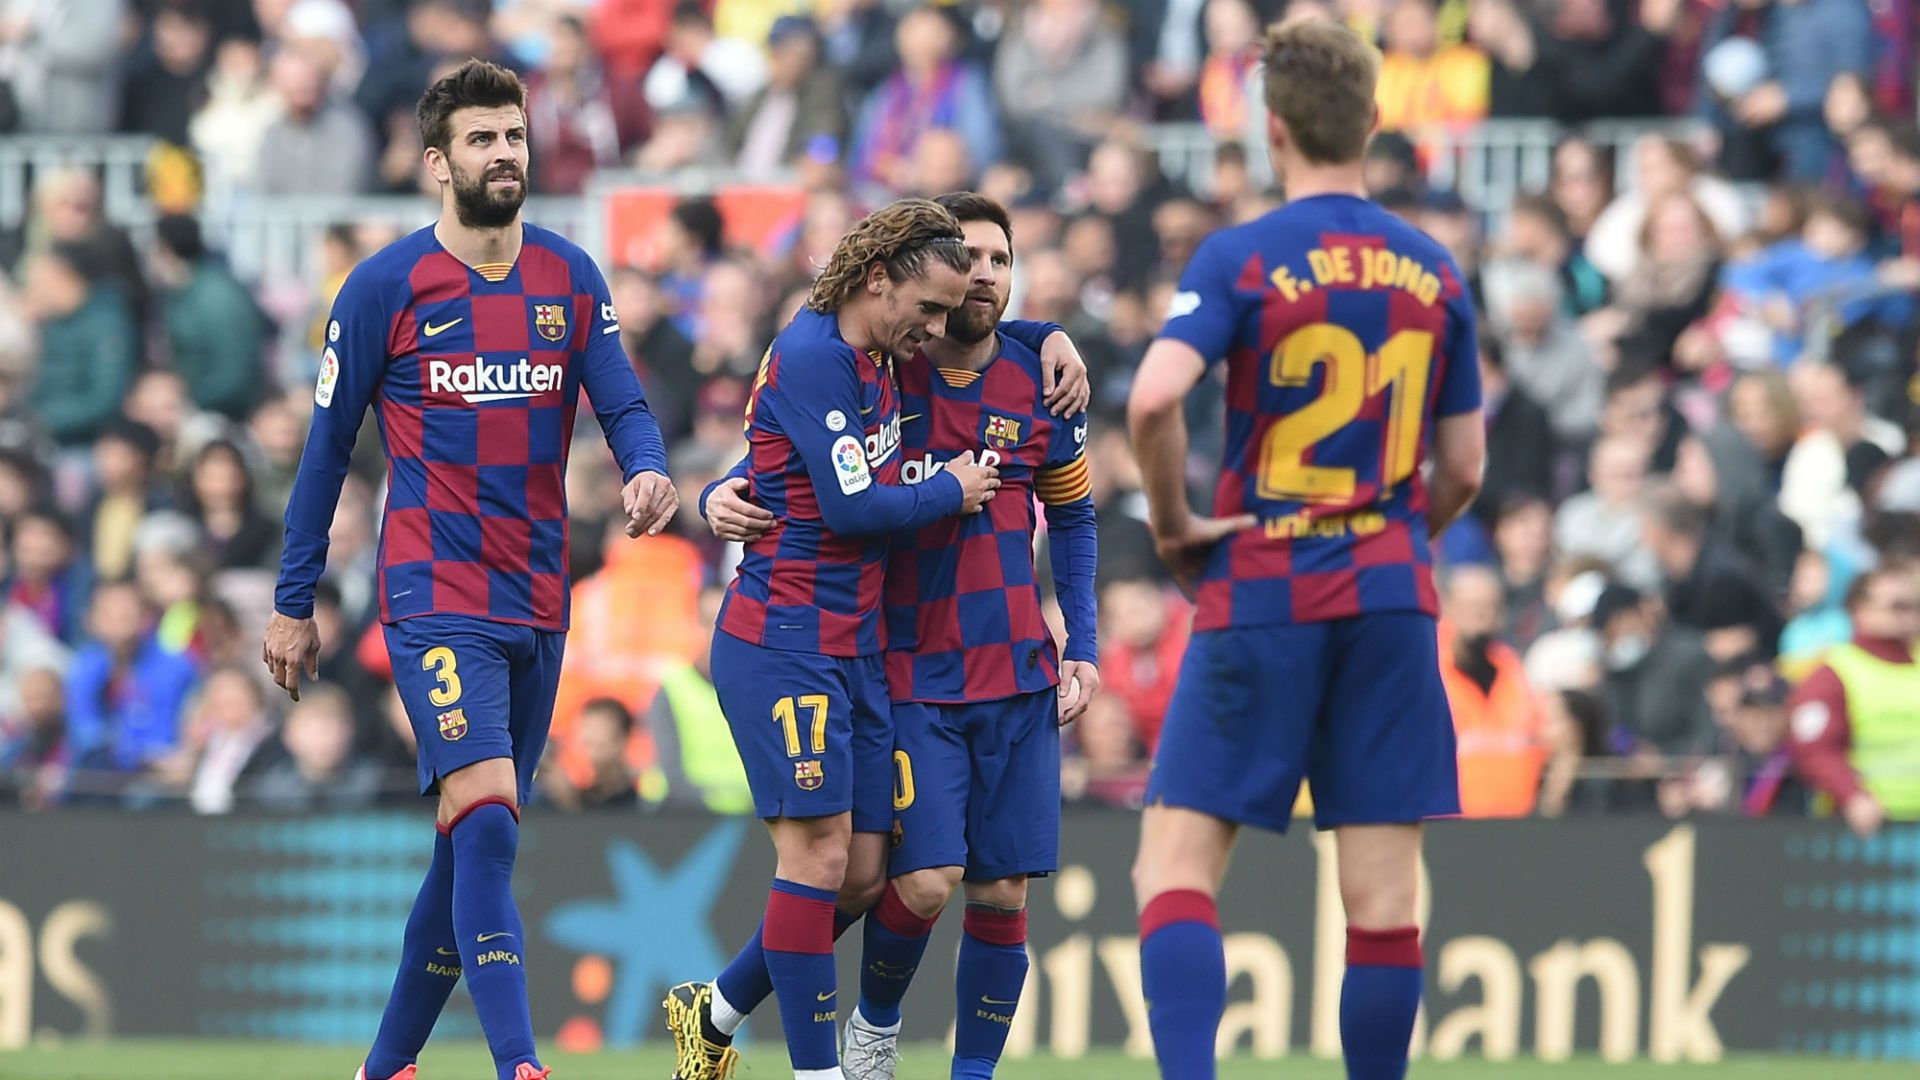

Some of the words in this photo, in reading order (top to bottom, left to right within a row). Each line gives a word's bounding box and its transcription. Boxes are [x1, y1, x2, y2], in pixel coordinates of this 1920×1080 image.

[1270, 264, 1313, 304] F.
[1306, 247, 1356, 286] DE
[429, 356, 563, 393] Rakuten
[1256, 323, 1434, 505] 21
[422, 645, 462, 707] 3
[772, 694, 829, 758] 17
[893, 749, 916, 811] 0
[426, 961, 463, 978] BARÇ
[476, 949, 520, 966] BARÇA
[814, 1010, 838, 1023] BAR
